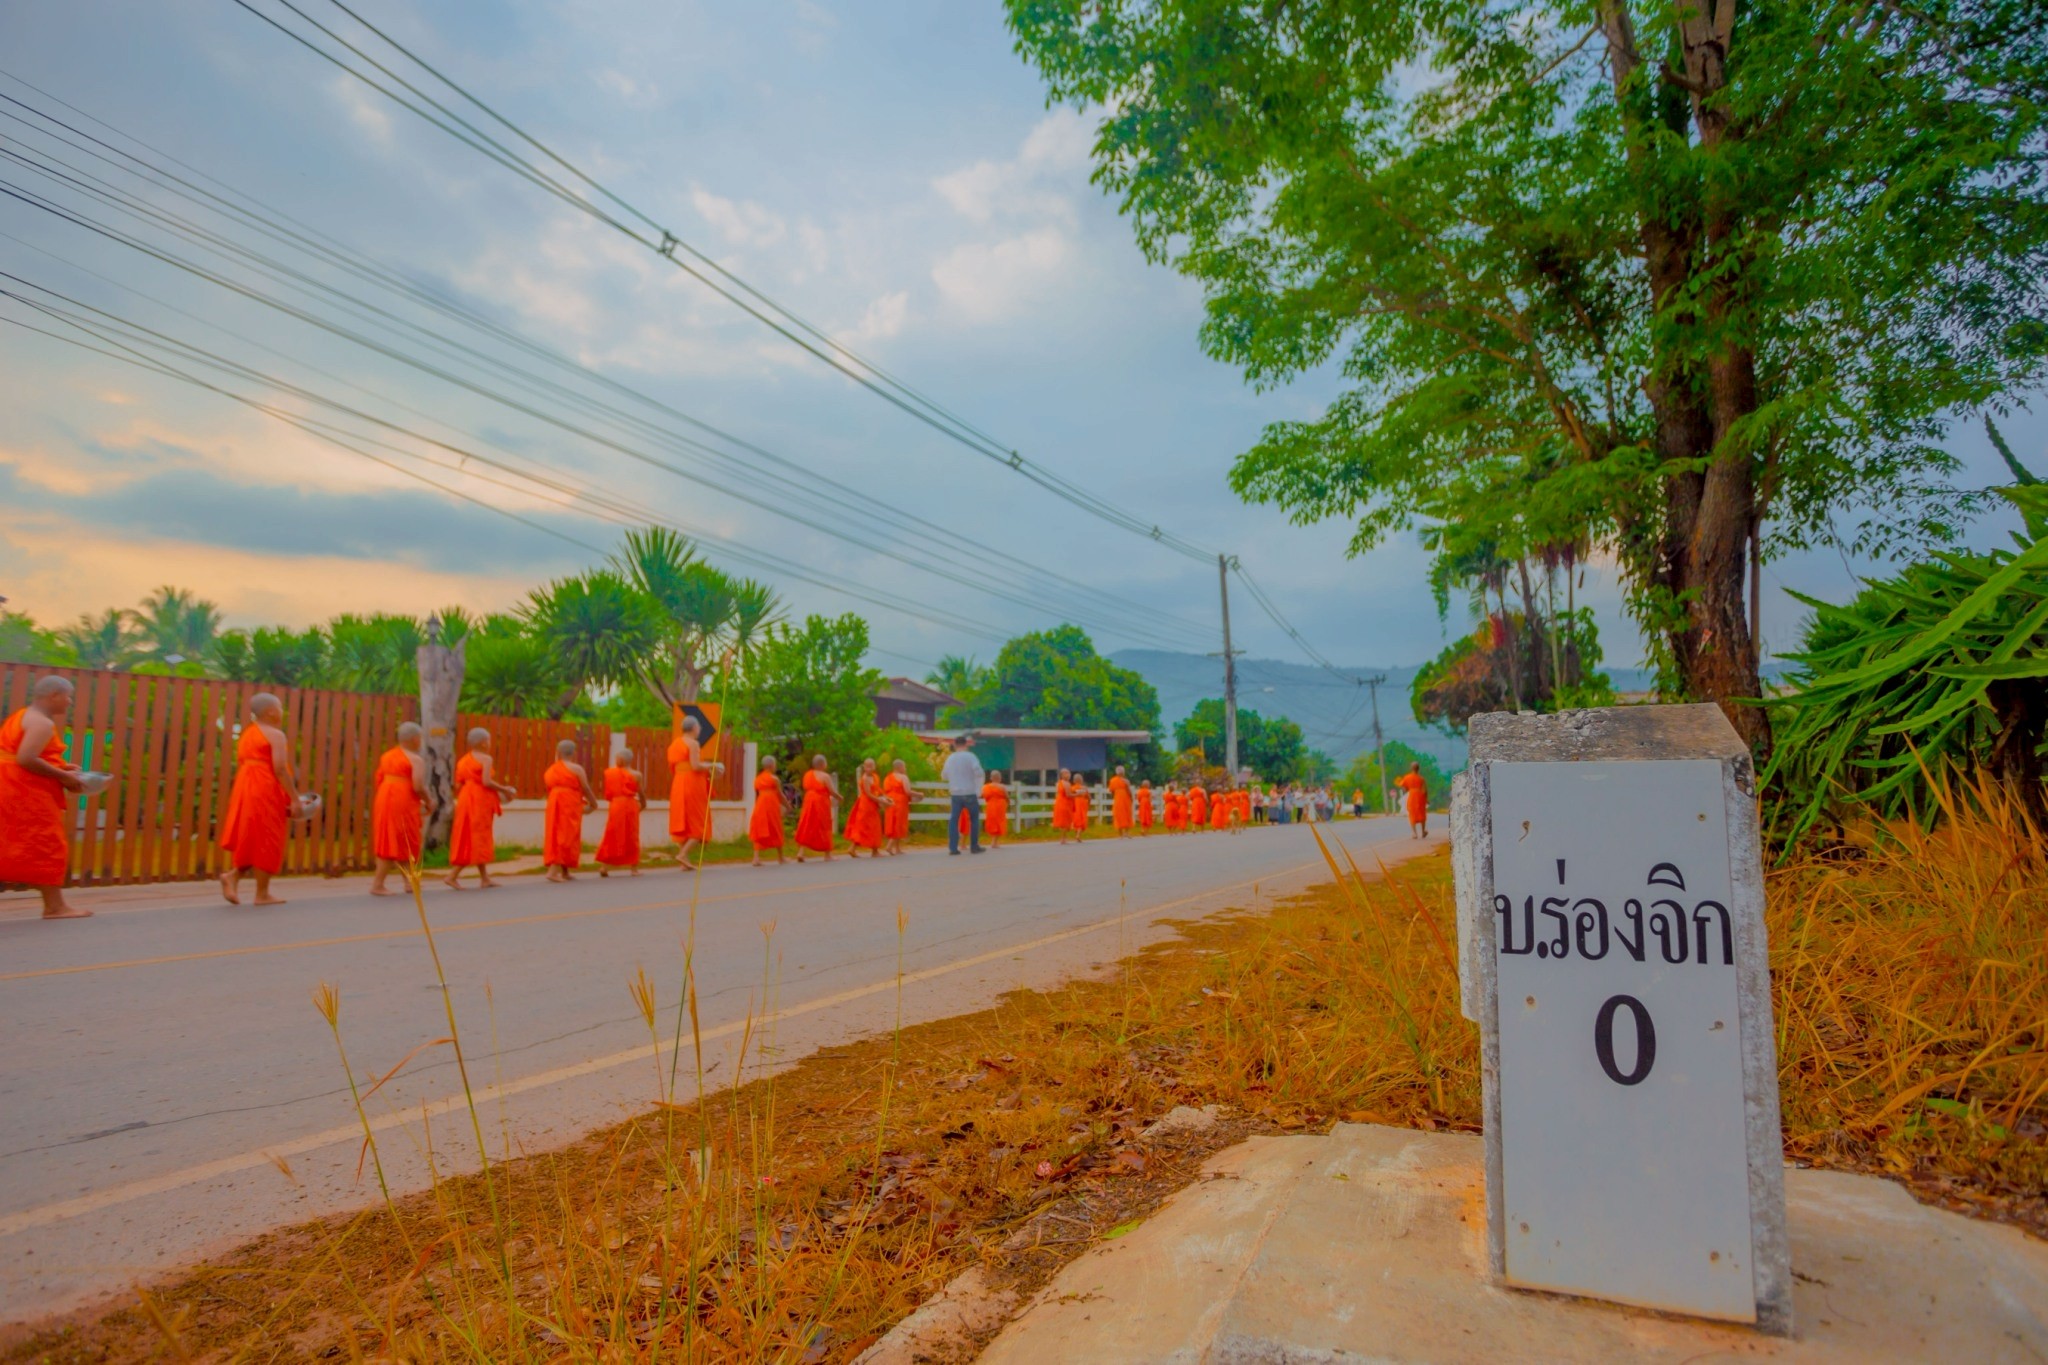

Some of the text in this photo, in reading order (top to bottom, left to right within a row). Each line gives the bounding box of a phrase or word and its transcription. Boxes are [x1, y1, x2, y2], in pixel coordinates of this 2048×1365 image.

[1493, 858, 1734, 966] บ.ร่องจิก
[1594, 994, 1656, 1086] 0
